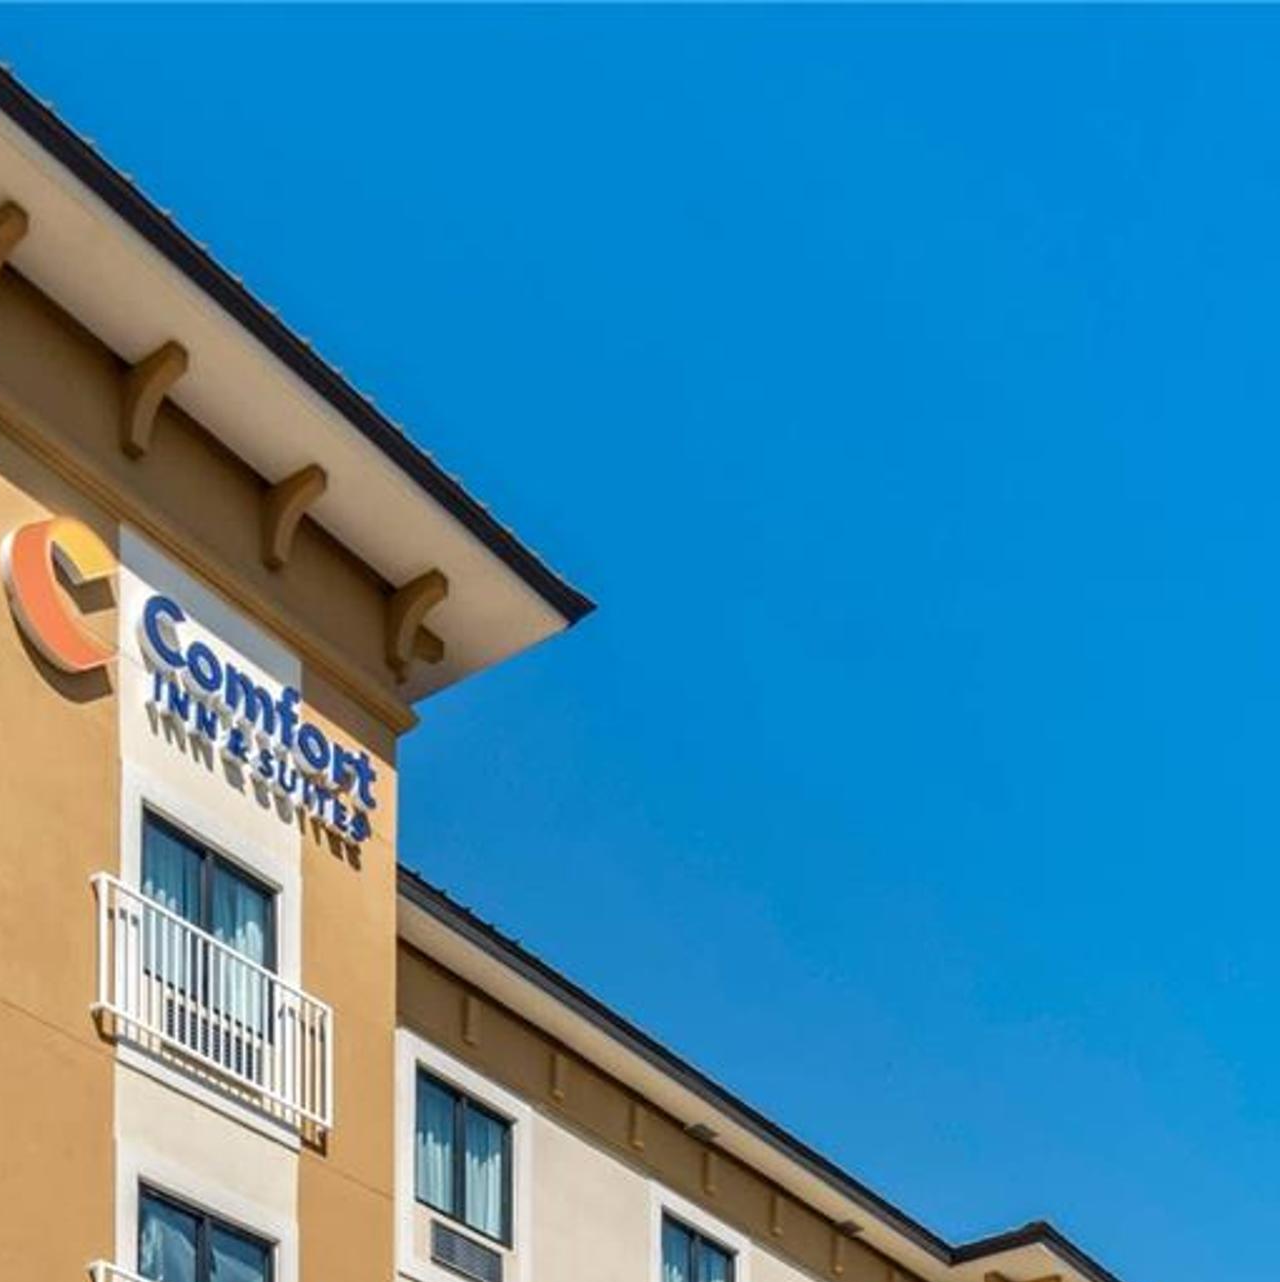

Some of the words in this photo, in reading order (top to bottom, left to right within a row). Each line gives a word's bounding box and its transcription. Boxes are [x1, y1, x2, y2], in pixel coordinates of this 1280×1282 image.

[142, 595, 377, 810] Comfort
[153, 671, 218, 741] INN
[228, 728, 250, 763] &
[258, 749, 370, 842] SUITES
